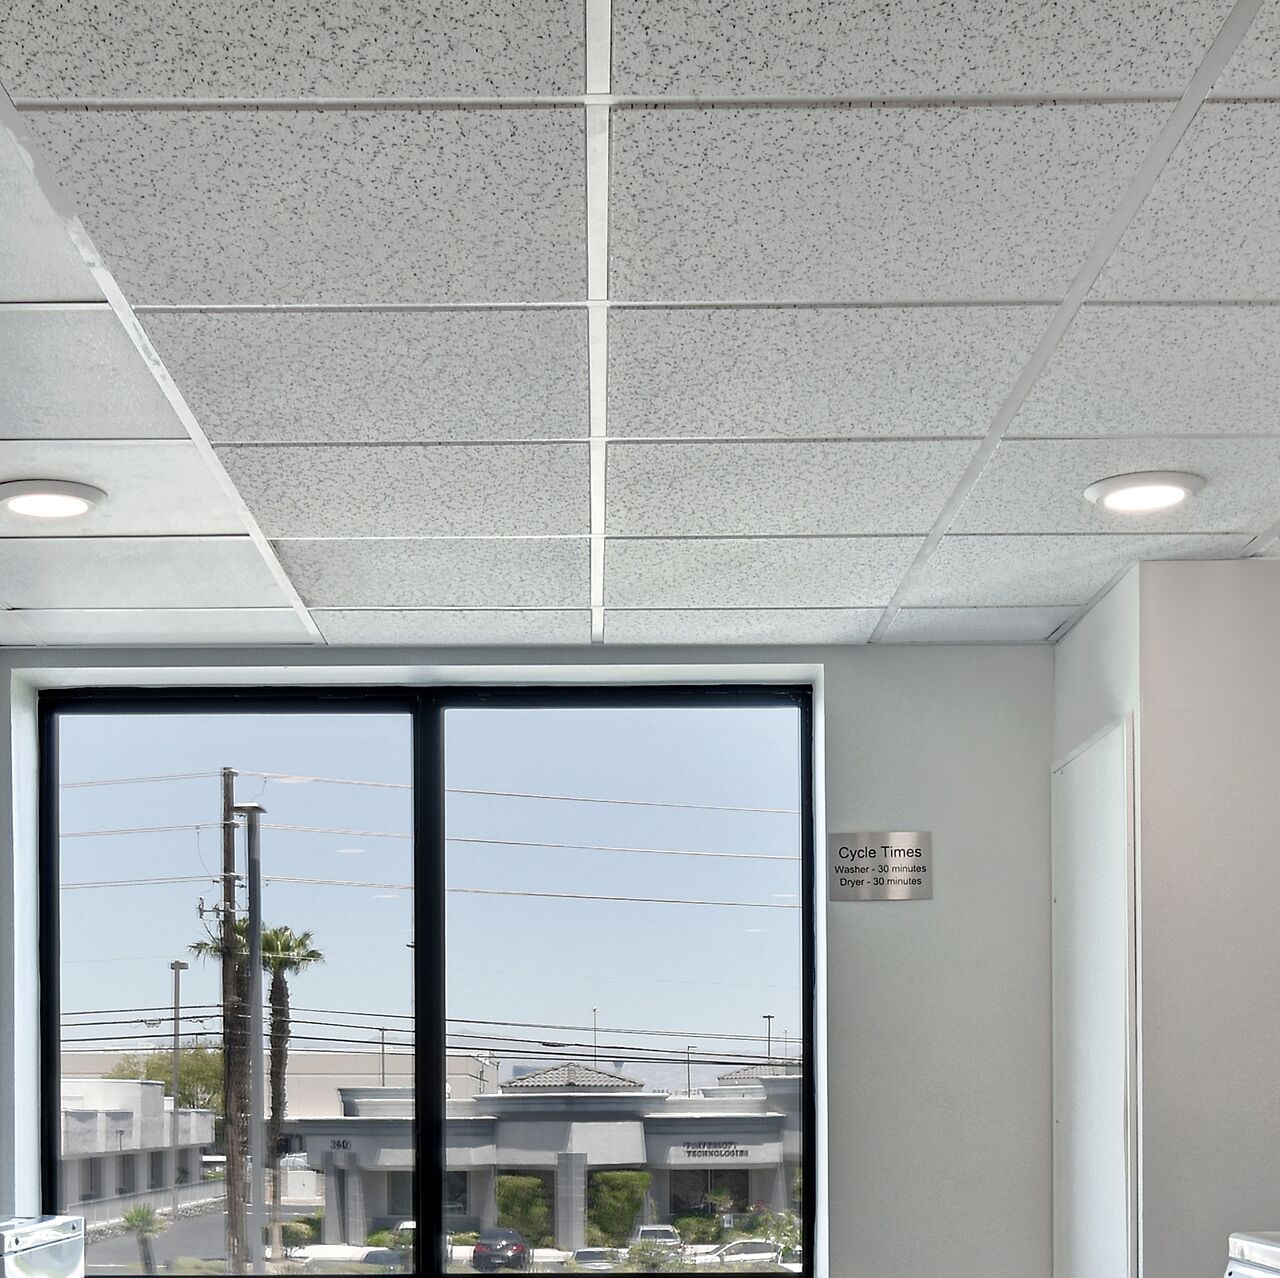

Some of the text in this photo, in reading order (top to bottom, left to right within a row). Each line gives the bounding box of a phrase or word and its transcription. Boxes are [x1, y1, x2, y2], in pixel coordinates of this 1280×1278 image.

[838, 845, 922, 862] Cycle Times
[834, 865, 870, 874] Washer
[878, 865, 889, 873] 30
[891, 865, 927, 873] minutes
[840, 877, 865, 888] Dryer
[873, 877, 885, 886] 30
[887, 877, 922, 886] minutes
